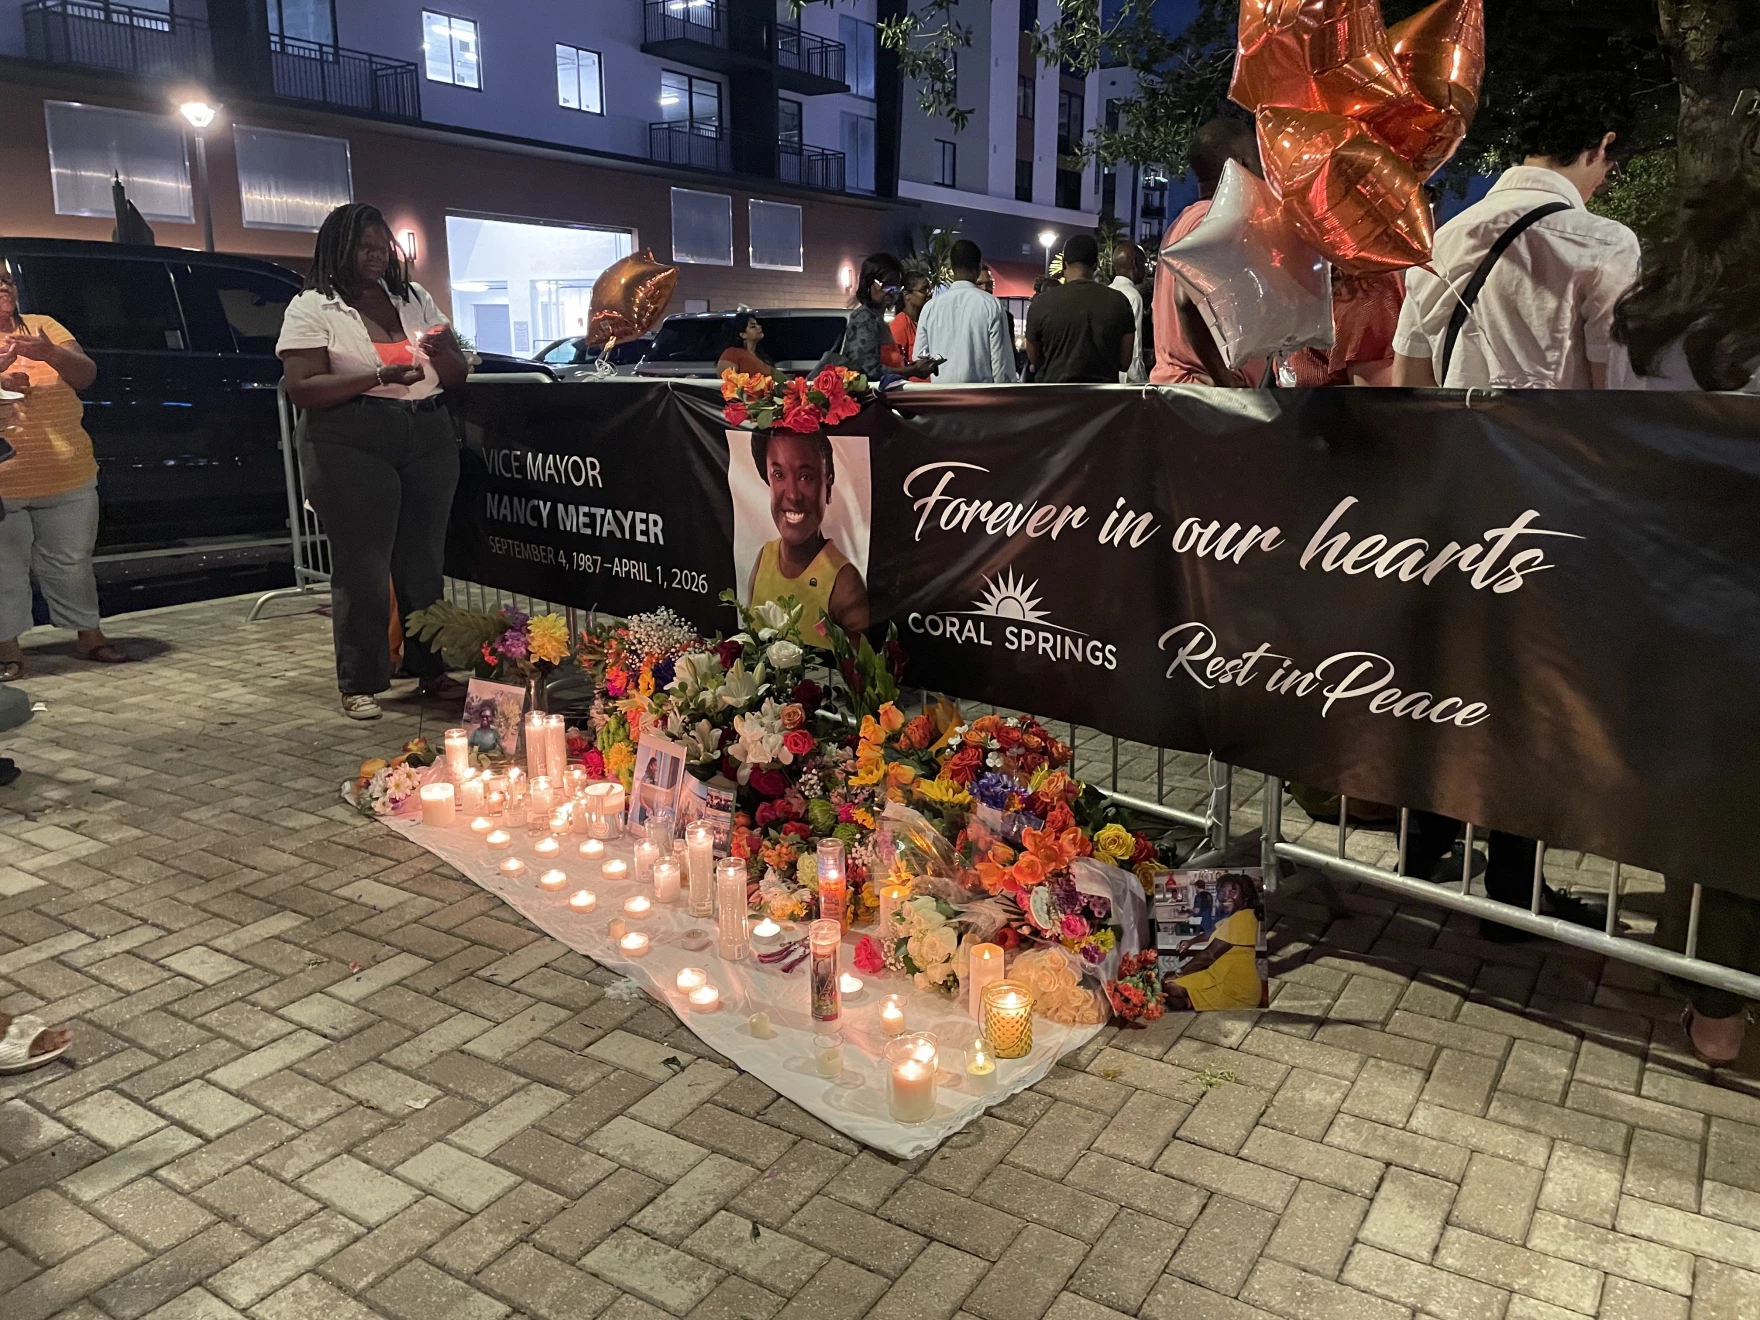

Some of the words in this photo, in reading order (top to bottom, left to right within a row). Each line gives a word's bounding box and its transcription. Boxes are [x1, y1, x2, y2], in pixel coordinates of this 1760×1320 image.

[482, 447, 522, 478] VICE
[526, 451, 602, 488] MAYOR
[486, 492, 551, 528] NANCY
[557, 502, 664, 545] METAYER
[903, 461, 1089, 541] Forever
[1098, 496, 1161, 548] in
[1172, 517, 1285, 564] our
[1300, 495, 1586, 593] hearts
[488, 535, 555, 564] SEPTEMBER
[557, 550, 569, 571] 4,
[655, 565, 667, 589] 1,
[671, 569, 708, 594] 2026
[908, 612, 992, 645] CORAL
[1004, 626, 1117, 670] SPRINGS
[1158, 621, 1294, 690] Rest
[1266, 658, 1319, 697] in
[1315, 651, 1490, 728] Peace
